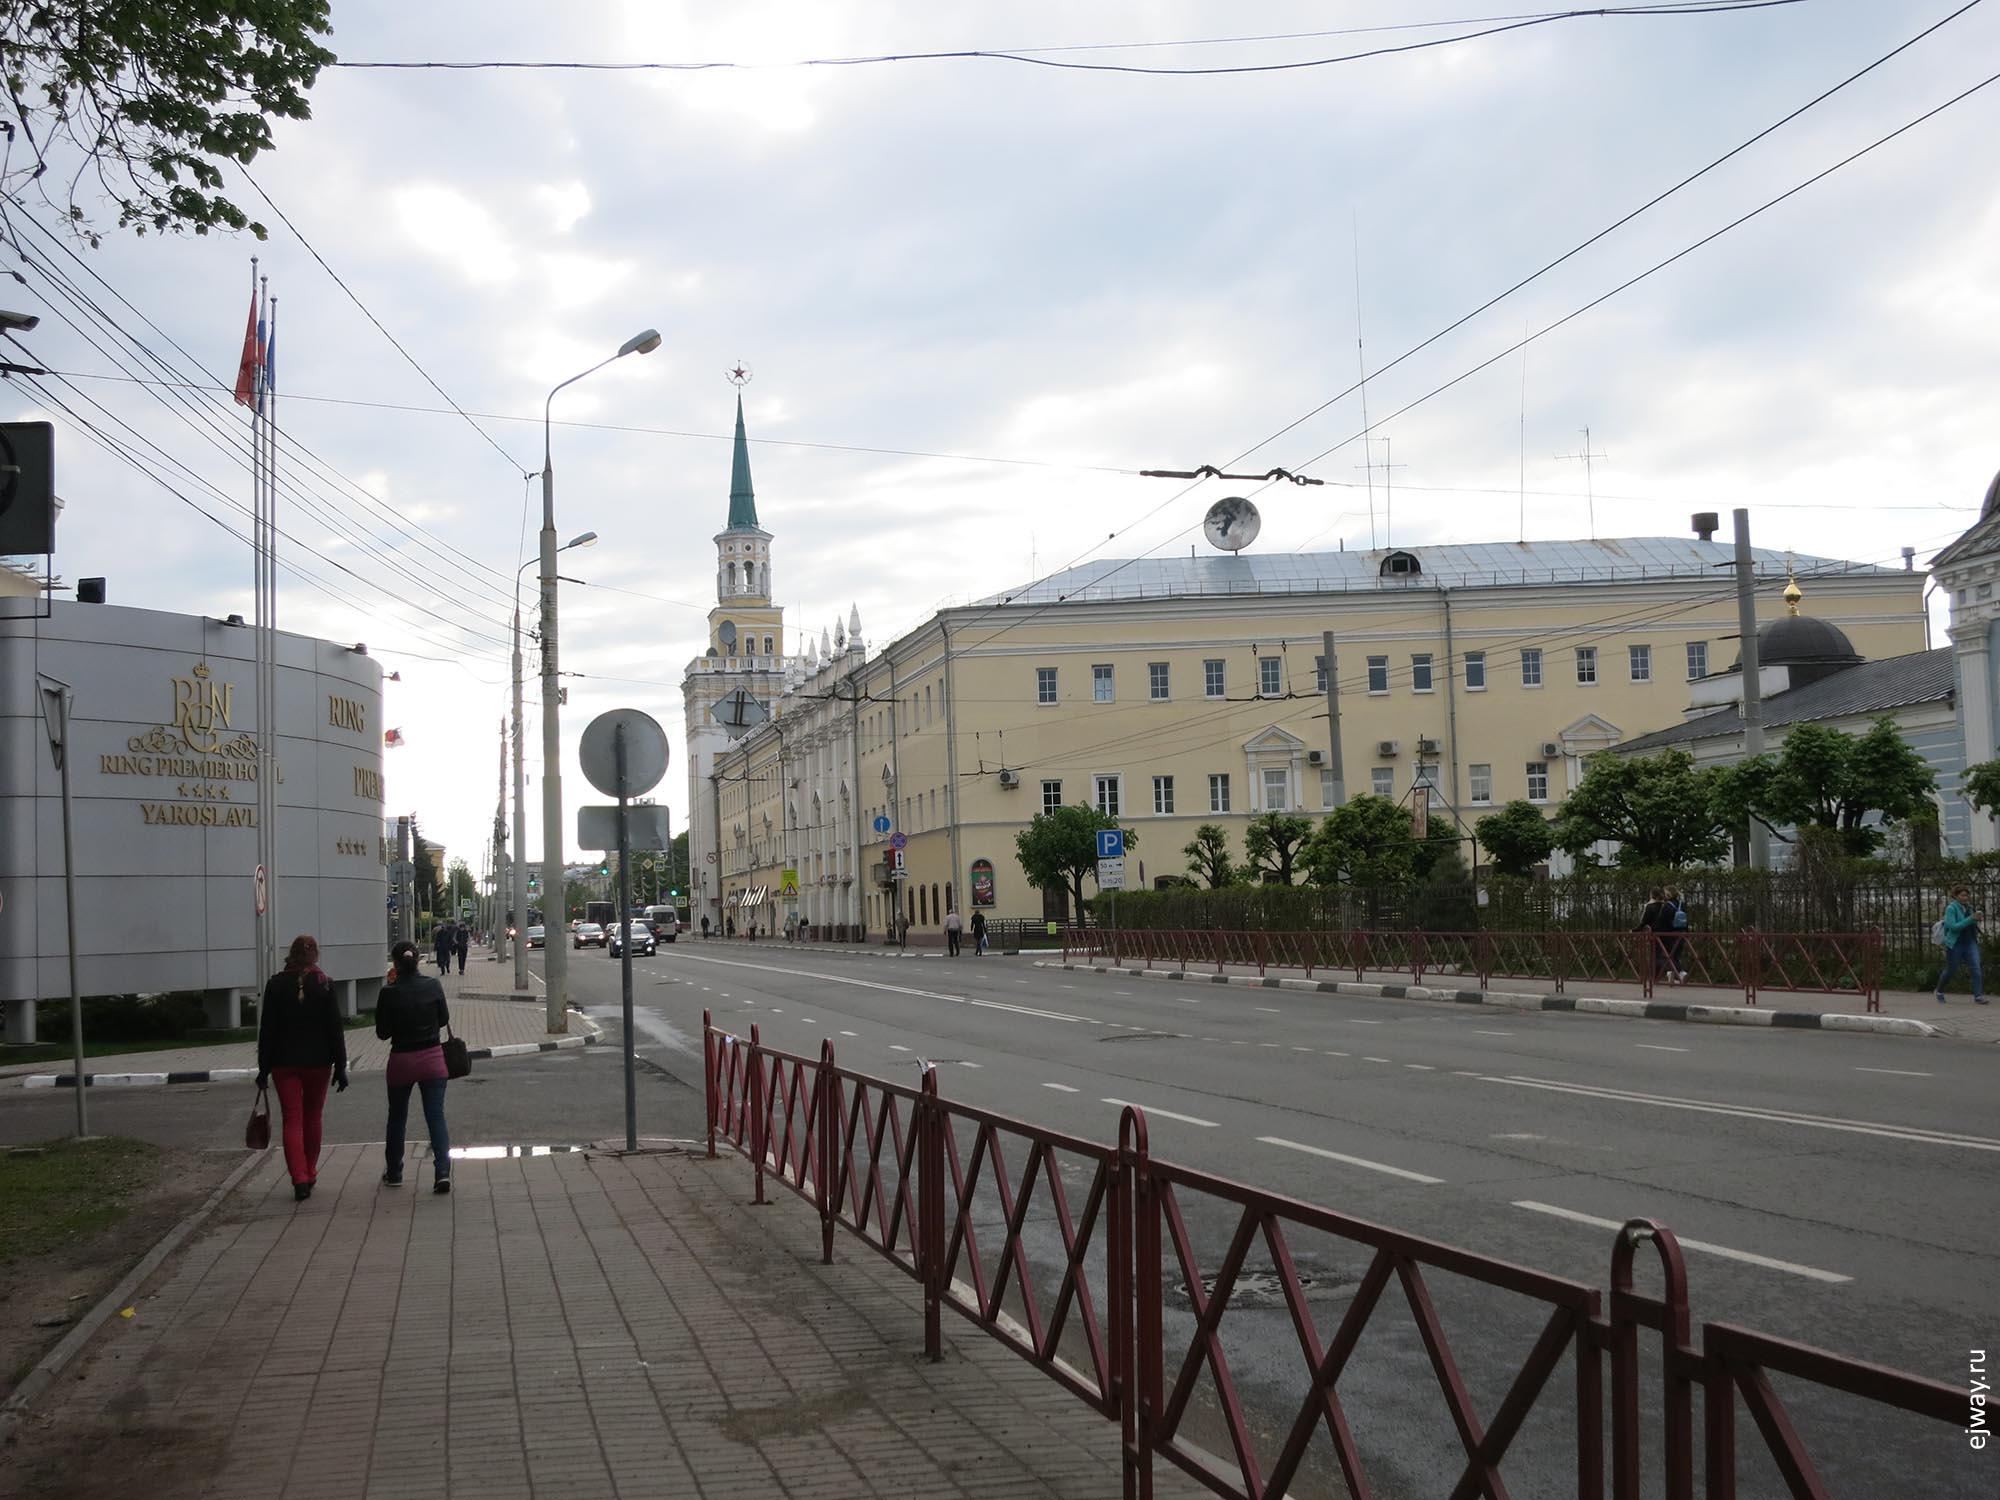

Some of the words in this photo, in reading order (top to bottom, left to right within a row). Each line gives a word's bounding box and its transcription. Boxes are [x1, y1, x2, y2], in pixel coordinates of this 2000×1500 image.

[329, 695, 365, 733] RING
[100, 755, 152, 776] RING
[156, 758, 233, 781] PREMIER
[235, 763, 284, 784] HOL
[140, 804, 258, 828] YAROSLAVL
[1104, 833, 1118, 854] P
